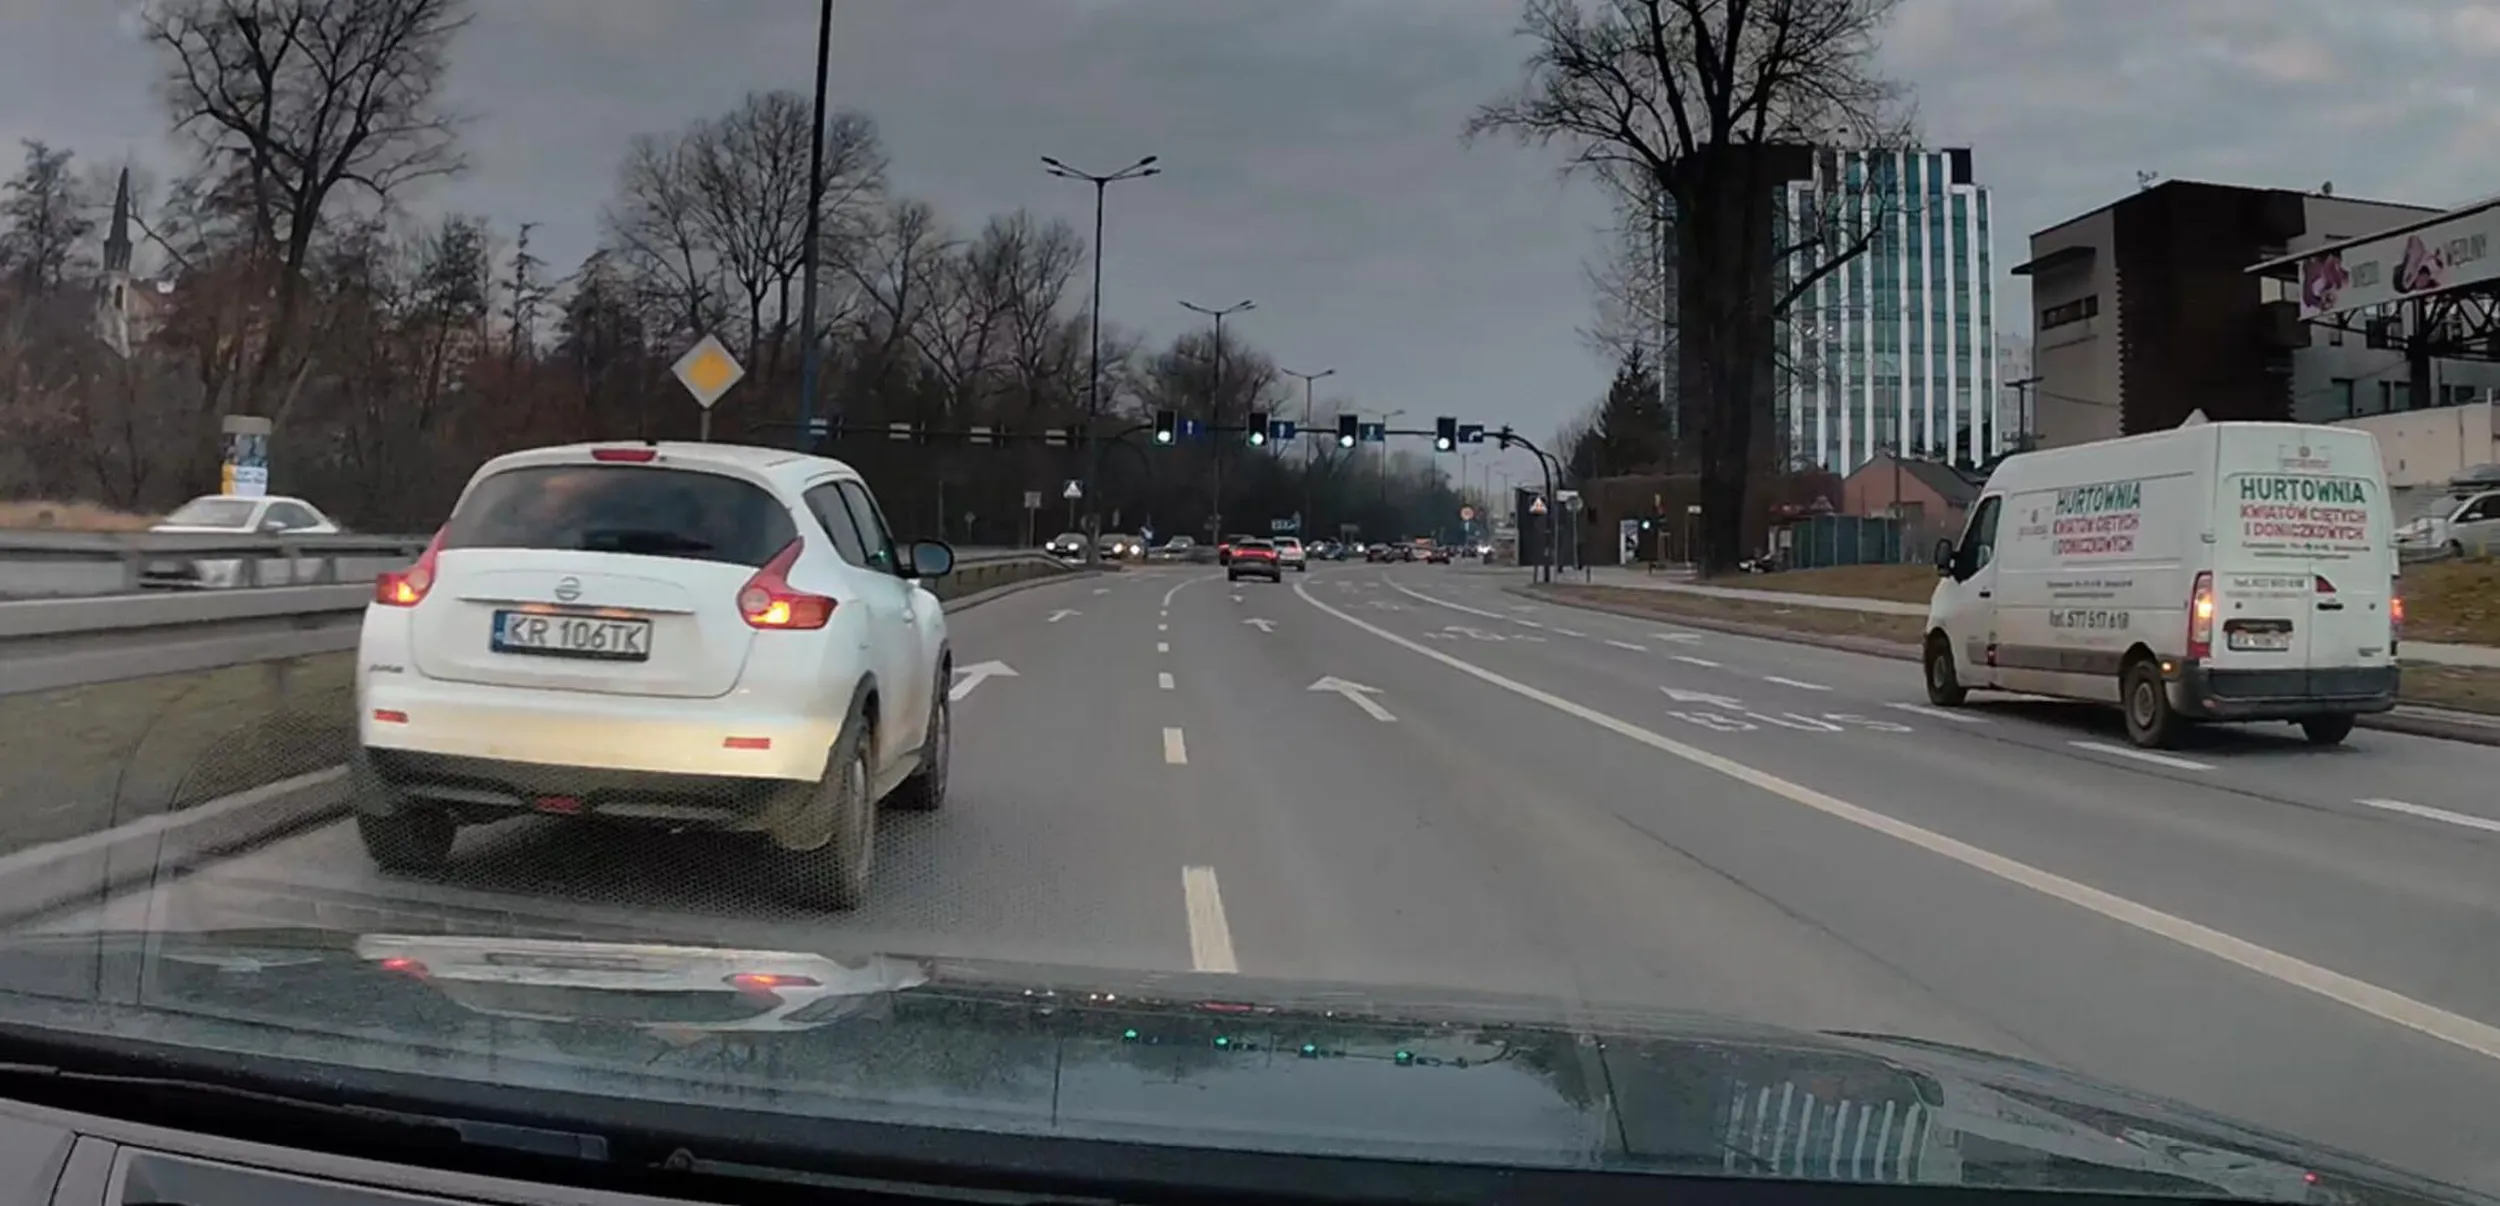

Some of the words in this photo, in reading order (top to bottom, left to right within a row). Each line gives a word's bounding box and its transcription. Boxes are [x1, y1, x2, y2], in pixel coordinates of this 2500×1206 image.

[2056, 481, 2140, 515] HURTOWNIA
[2240, 478, 2366, 504] HURTOWNIA
[2240, 503, 2307, 520] KWIATÓW
[2244, 522, 2250, 536] I
[510, 615, 549, 646] KR
[559, 619, 644, 653] 106TK
